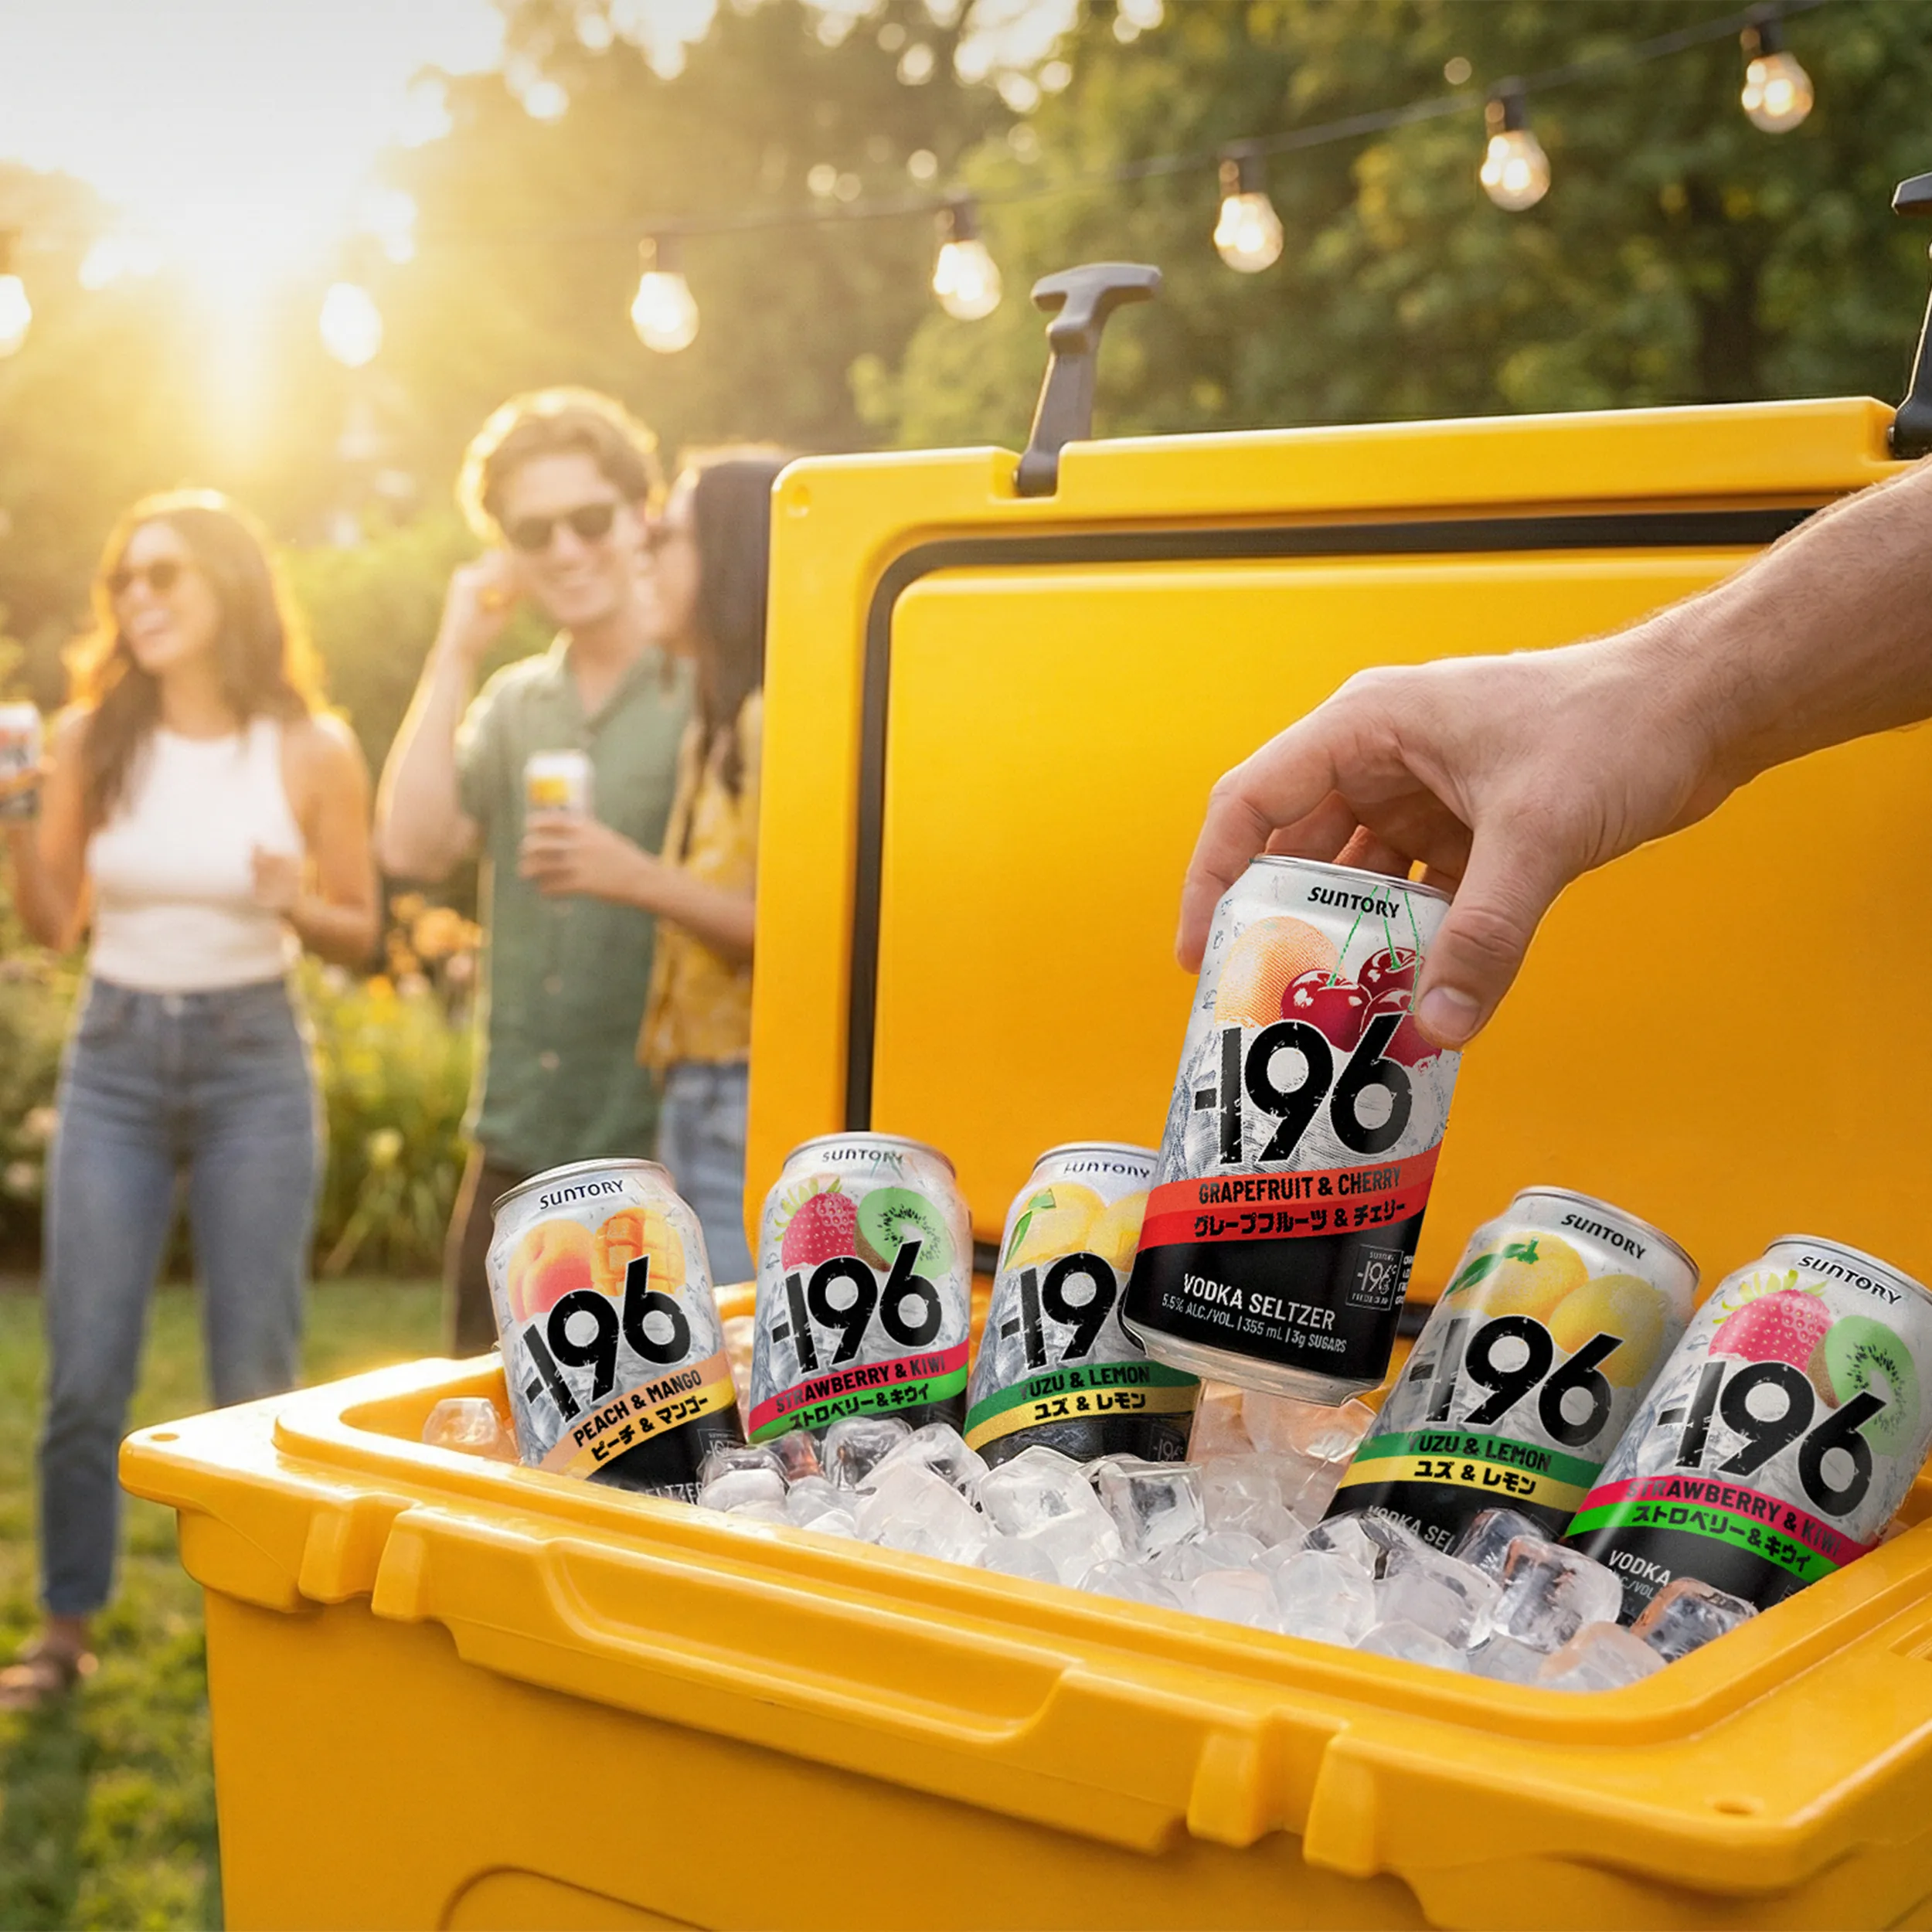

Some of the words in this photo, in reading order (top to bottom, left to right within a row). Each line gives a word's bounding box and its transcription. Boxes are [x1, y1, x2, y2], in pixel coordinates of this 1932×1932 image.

[1307, 886, 1400, 919] SUNTORY
[1195, 1011, 1413, 1165] -196
[539, 1179, 624, 1209] SUNTORY
[1199, 1176, 1314, 1205] GRAPEFRUIT
[1318, 1176, 1333, 1196] &
[1338, 1165, 1402, 1196] CHERRY
[1194, 1209, 1327, 1237] グレープフルーツ
[1334, 1208, 1349, 1228] &
[1354, 1199, 1406, 1226] チェリー
[1561, 1213, 1647, 1260] SUNTORY
[772, 1240, 943, 1374] -196
[1183, 1273, 1243, 1310] VODKA
[1248, 1292, 1336, 1331] SELTZER
[1798, 1254, 1902, 1306] SUNTORY
[523, 1255, 692, 1423] -196
[1001, 1251, 1147, 1371] -19
[1162, 1293, 1184, 1313] 5.5%
[1243, 1318, 1264, 1335] 355
[1291, 1330, 1306, 1349] 3g
[1308, 1333, 1347, 1353] SUGARS
[573, 1403, 628, 1448] PEACH
[632, 1394, 647, 1408] &
[648, 1369, 702, 1401] MANGO
[777, 1365, 889, 1413] STRAWBERRY
[895, 1362, 907, 1378] &
[910, 1355, 946, 1377] KIWI
[1019, 1374, 1064, 1401] YUZU
[1070, 1372, 1085, 1388] &
[1090, 1366, 1151, 1387] LEMON
[1034, 1397, 1070, 1420] ユズ
[1076, 1395, 1090, 1410] &
[1096, 1391, 1146, 1412] レモン
[1409, 1315, 1624, 1447] -196
[591, 1423, 636, 1461] ピーチ
[640, 1417, 655, 1433] &
[655, 1394, 708, 1425] マンゴー
[1408, 1434, 1458, 1454] YUZU
[1463, 1439, 1479, 1455] &
[1485, 1443, 1552, 1473] LEMON
[1656, 1360, 1887, 1517] -196
[1414, 1460, 1453, 1480] ユズ
[1461, 1465, 1475, 1481] &
[1482, 1467, 1536, 1495] レモン
[1625, 1480, 1781, 1522] STRAWBERRY
[1784, 1512, 1797, 1531] &
[1800, 1521, 1842, 1559] KIWI
[1608, 1549, 1672, 1587] VODKA
